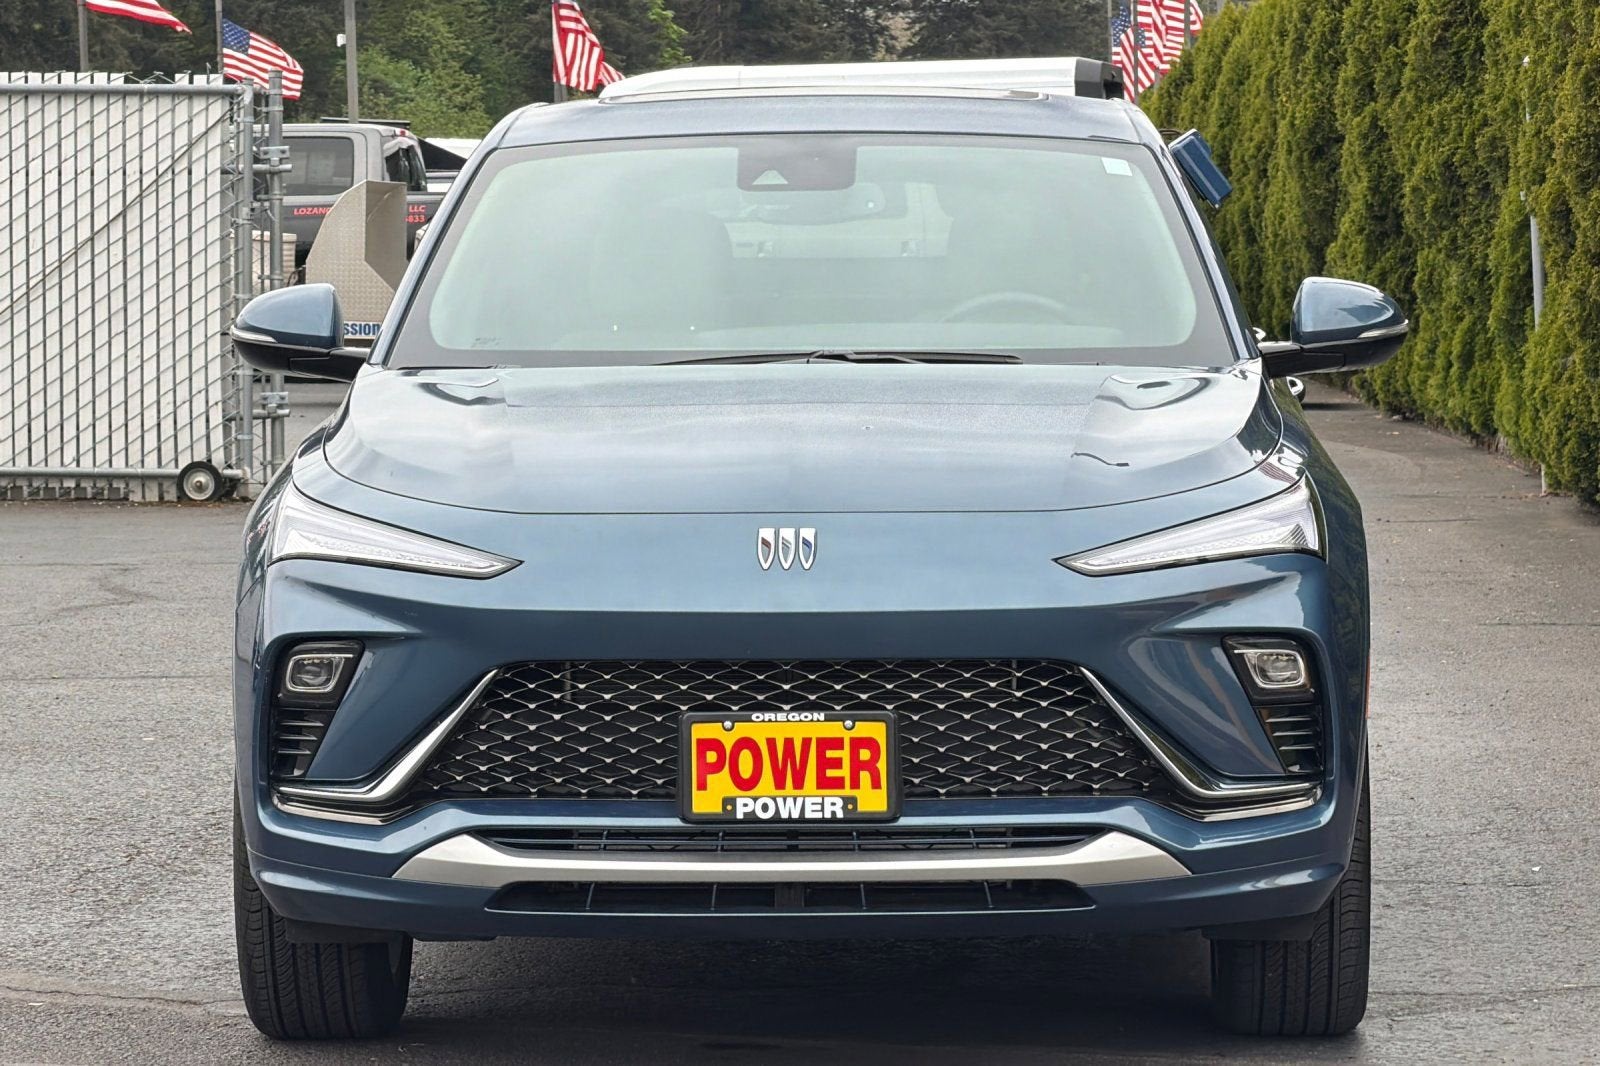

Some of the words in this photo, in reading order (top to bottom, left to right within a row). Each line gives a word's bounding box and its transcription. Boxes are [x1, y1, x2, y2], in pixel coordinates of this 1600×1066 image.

[409, 205, 427, 213] LLC
[405, 215, 426, 223] 833
[751, 712, 825, 722] OREGON
[696, 736, 882, 791] POWER
[735, 796, 844, 820] POWER
